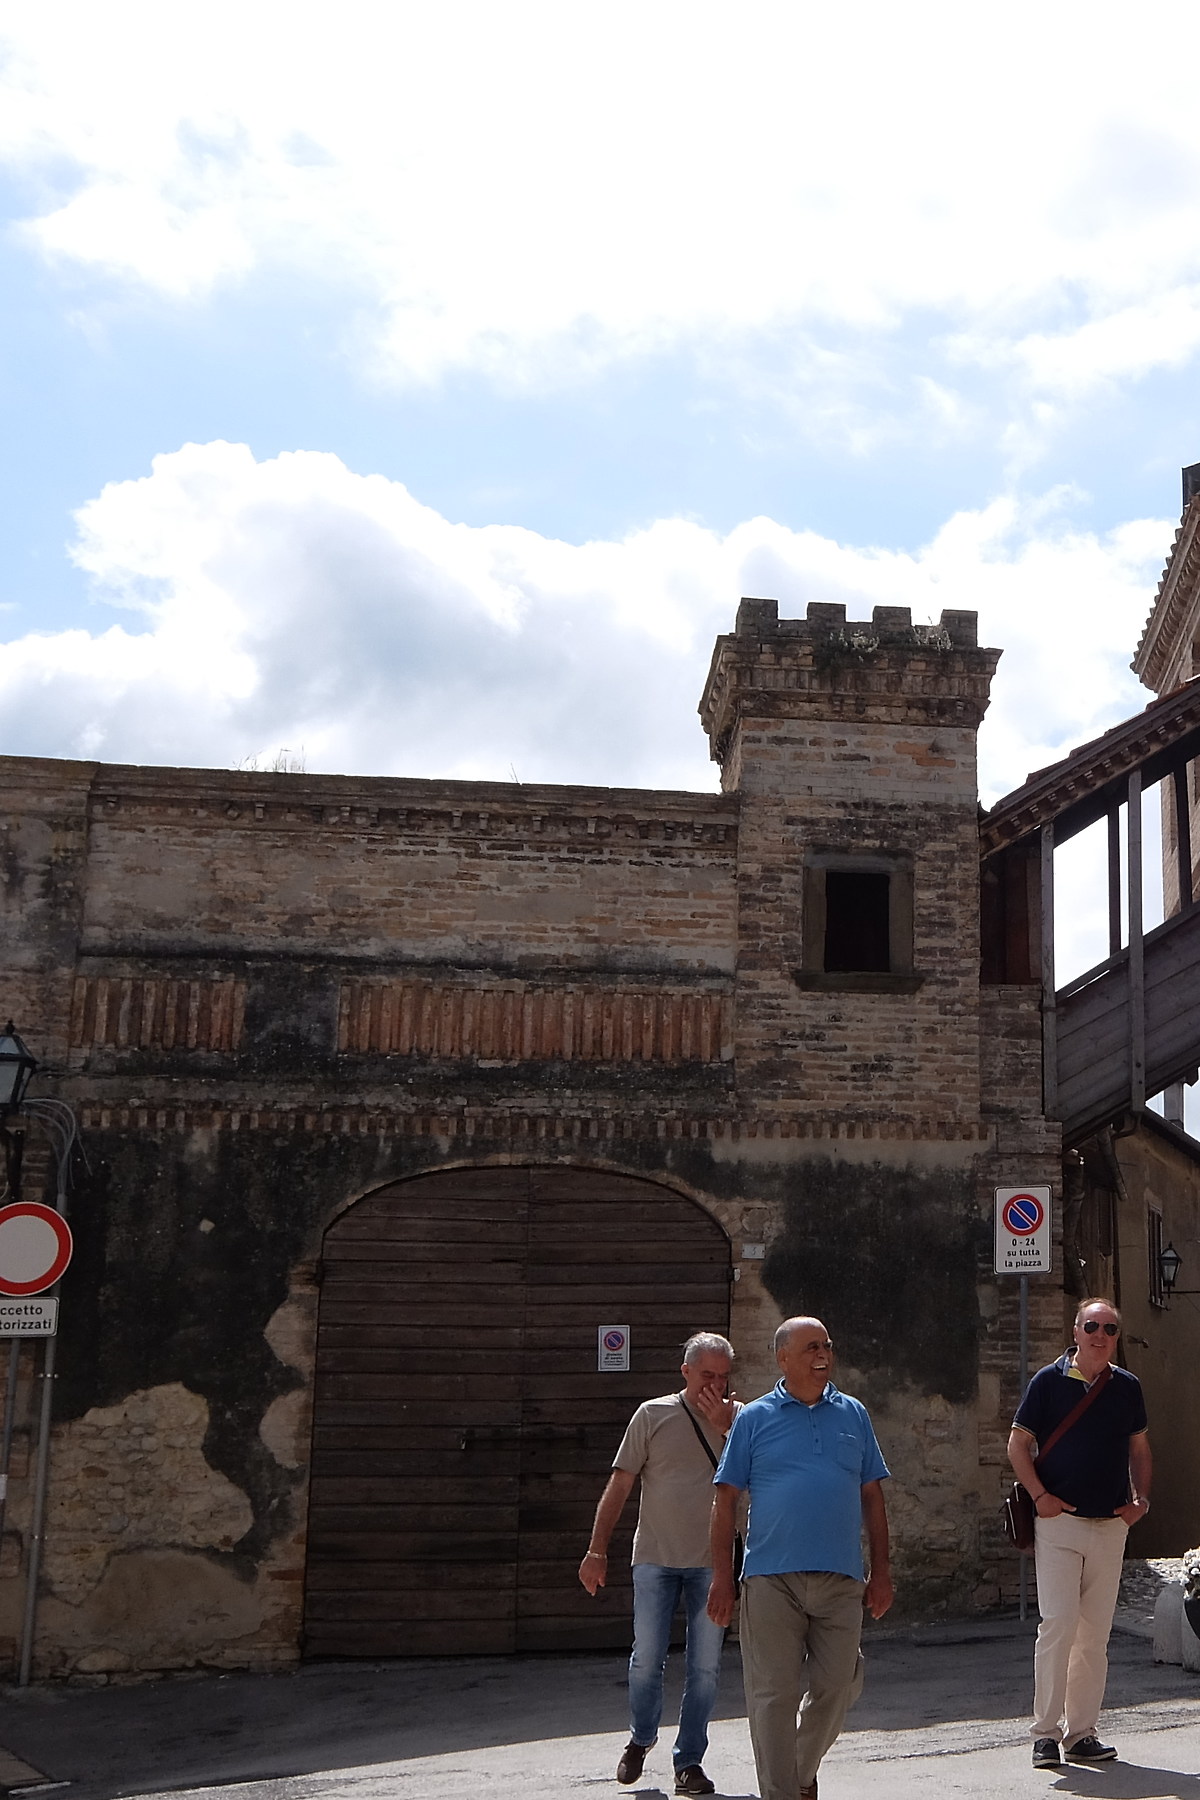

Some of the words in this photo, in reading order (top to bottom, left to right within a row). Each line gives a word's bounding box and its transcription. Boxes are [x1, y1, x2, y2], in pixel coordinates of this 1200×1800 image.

[1011, 1238, 1017, 1246] 0
[1025, 1237, 1035, 1246] 24
[1015, 1260, 1042, 1268] piazza
